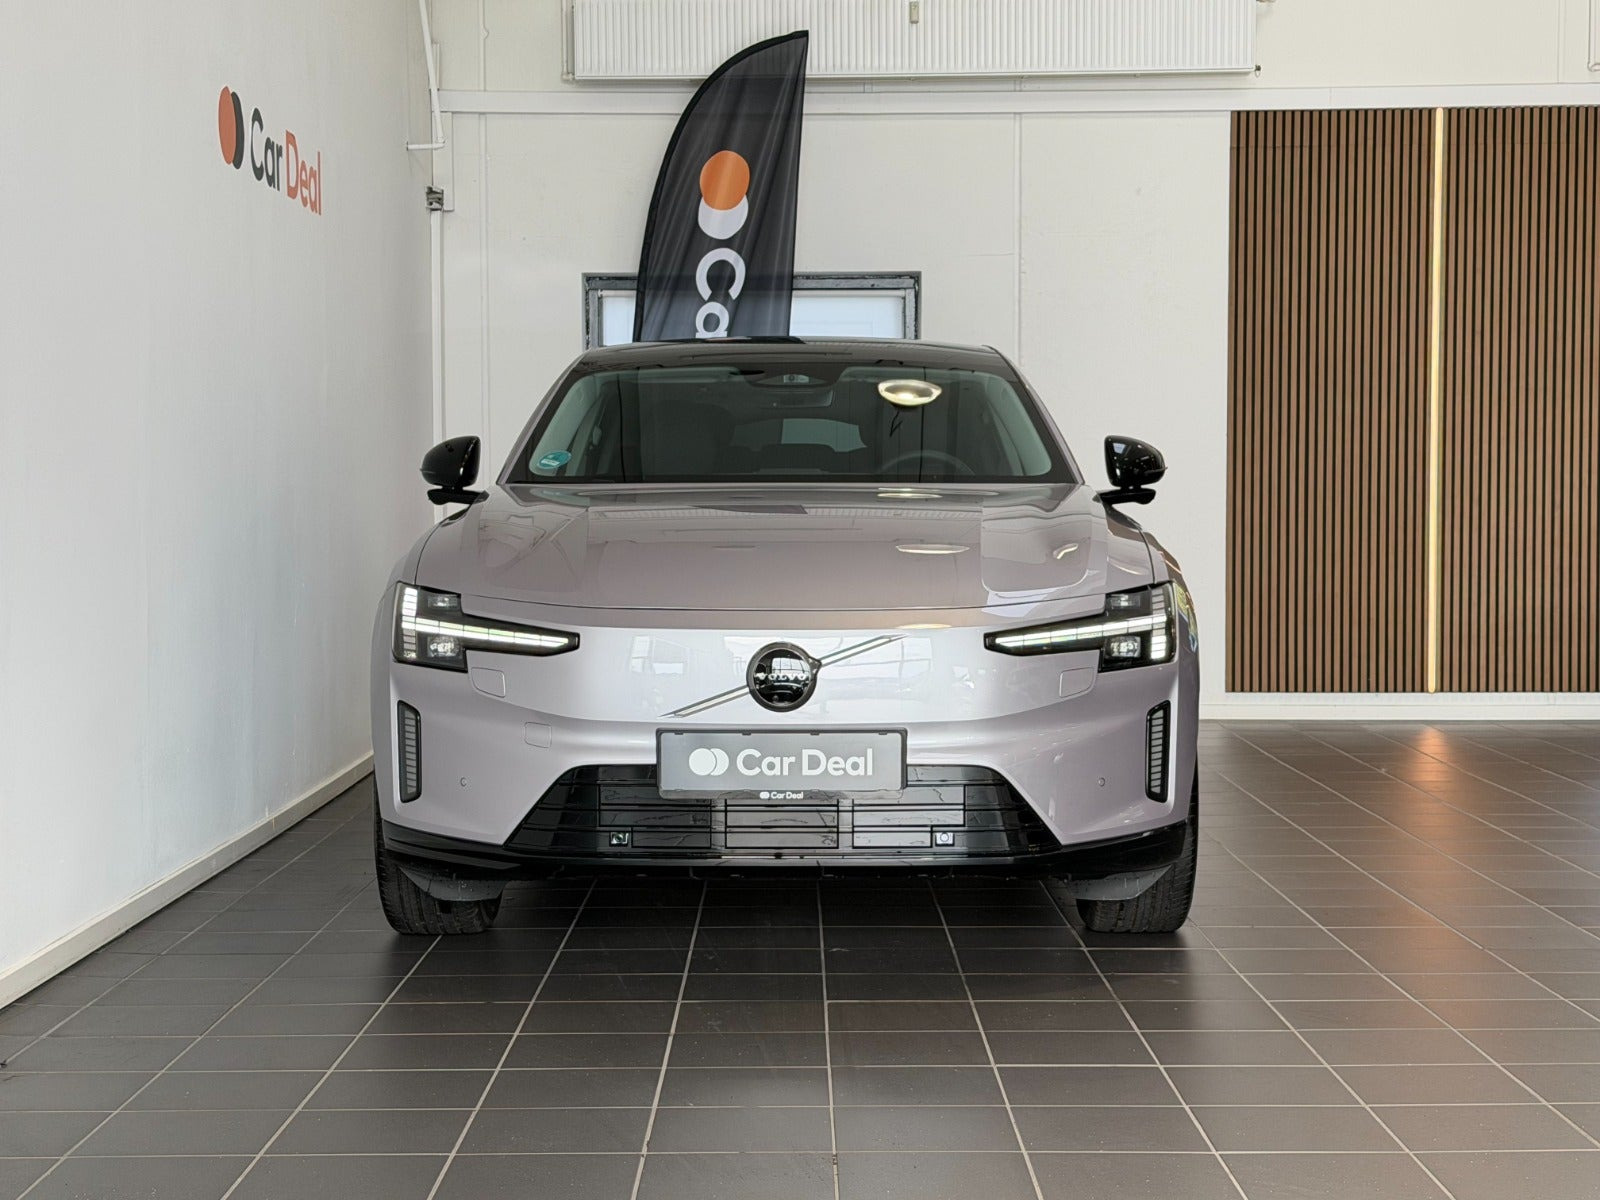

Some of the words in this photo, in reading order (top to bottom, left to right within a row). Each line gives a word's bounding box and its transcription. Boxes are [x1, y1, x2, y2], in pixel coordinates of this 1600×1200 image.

[251, 107, 283, 192] Car
[285, 129, 321, 216] Deal
[736, 748, 796, 776] Car
[801, 747, 873, 776] Deal
[770, 791, 785, 799] Car
[785, 791, 804, 799] Deal
